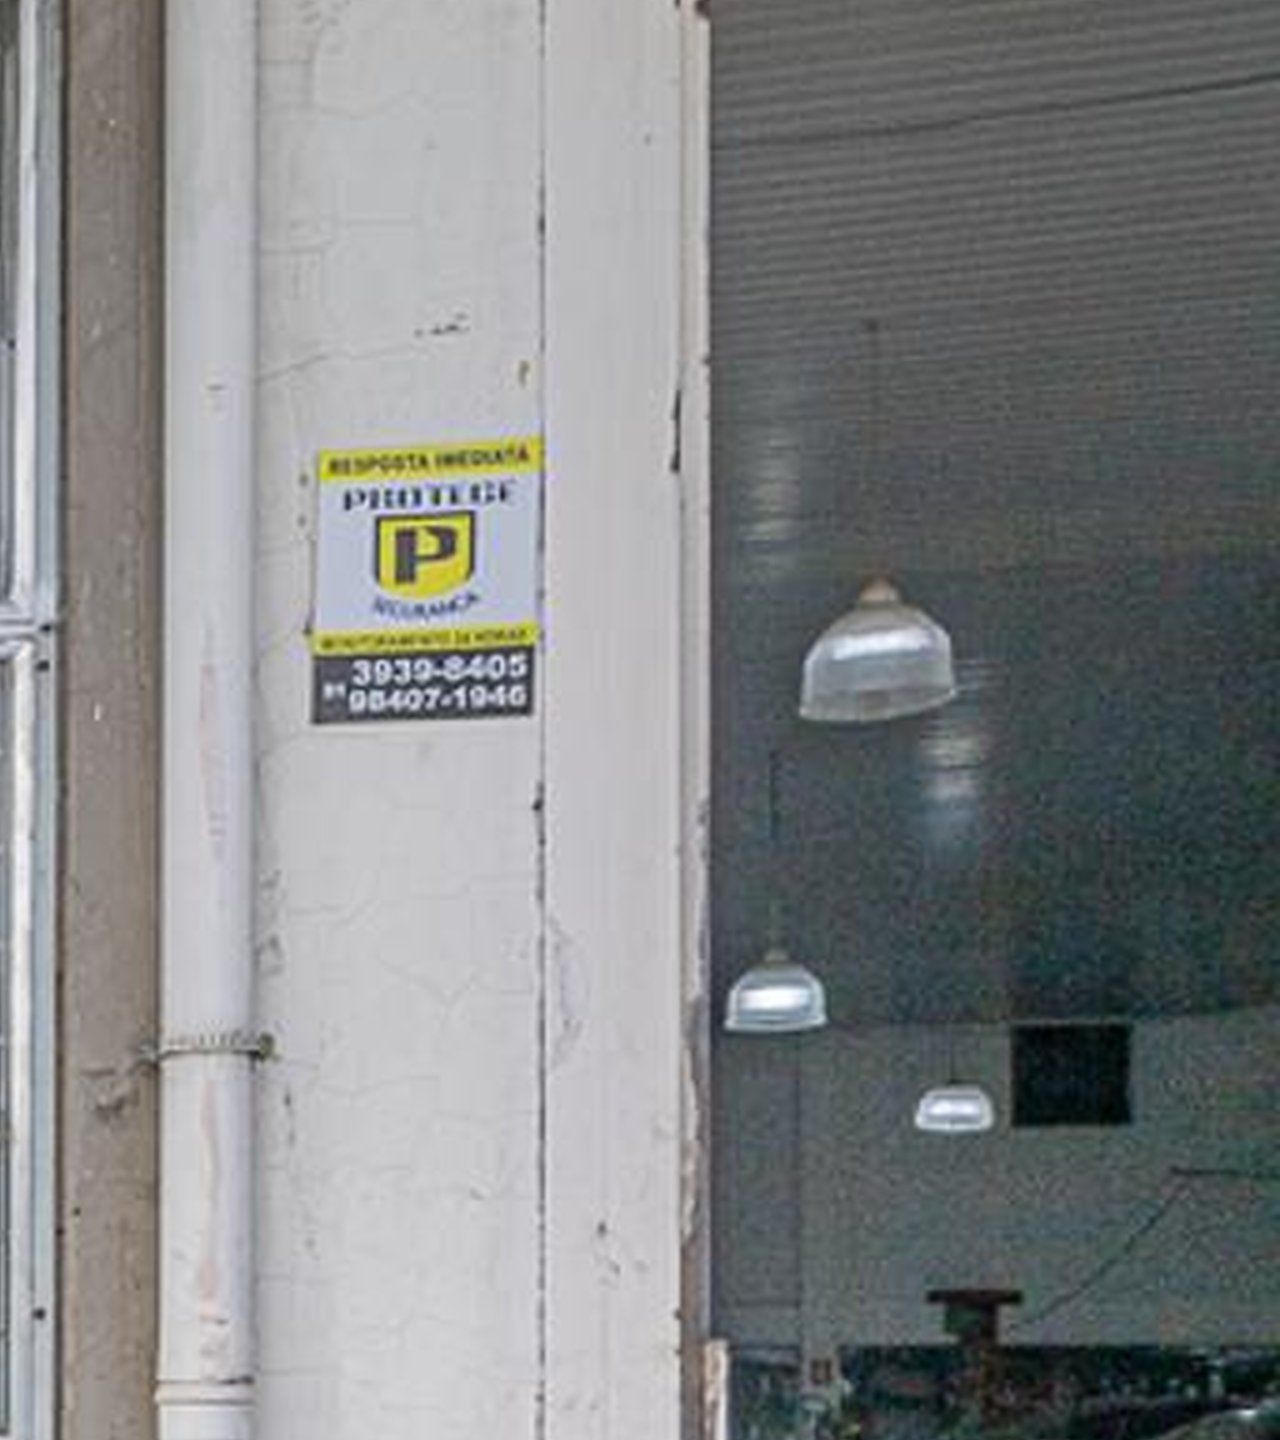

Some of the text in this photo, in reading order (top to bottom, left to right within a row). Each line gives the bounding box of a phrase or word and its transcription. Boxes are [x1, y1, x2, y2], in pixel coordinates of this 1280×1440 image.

[328, 441, 530, 475] RESPOSTA IMEDIATA
[394, 526, 458, 585] P
